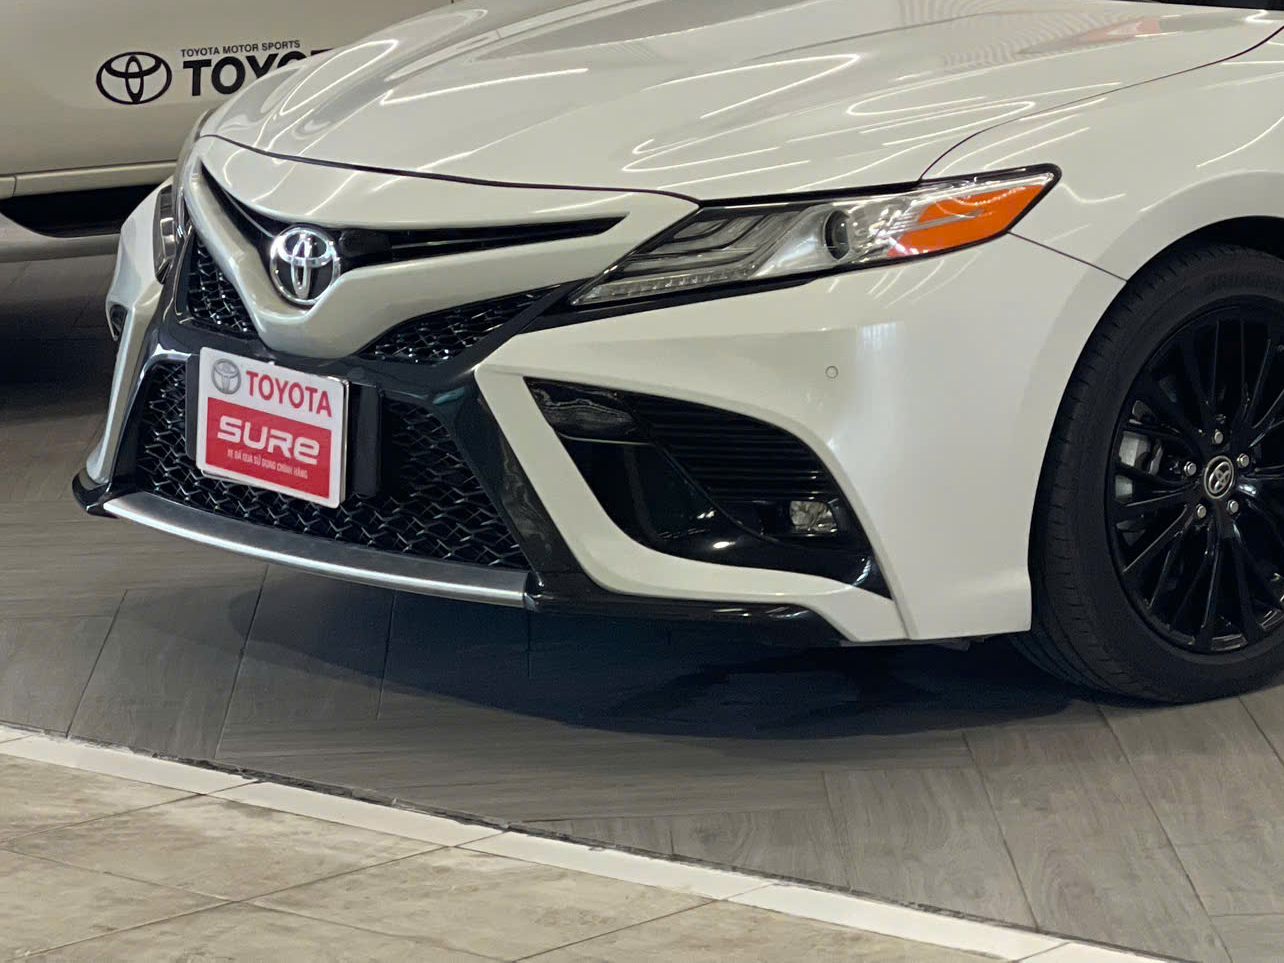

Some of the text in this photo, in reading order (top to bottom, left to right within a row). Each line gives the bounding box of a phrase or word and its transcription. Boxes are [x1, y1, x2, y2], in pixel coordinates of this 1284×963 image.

[181, 39, 301, 57] TOYOTA MOTOR SPORTS
[245, 370, 332, 418] TOYOTA
